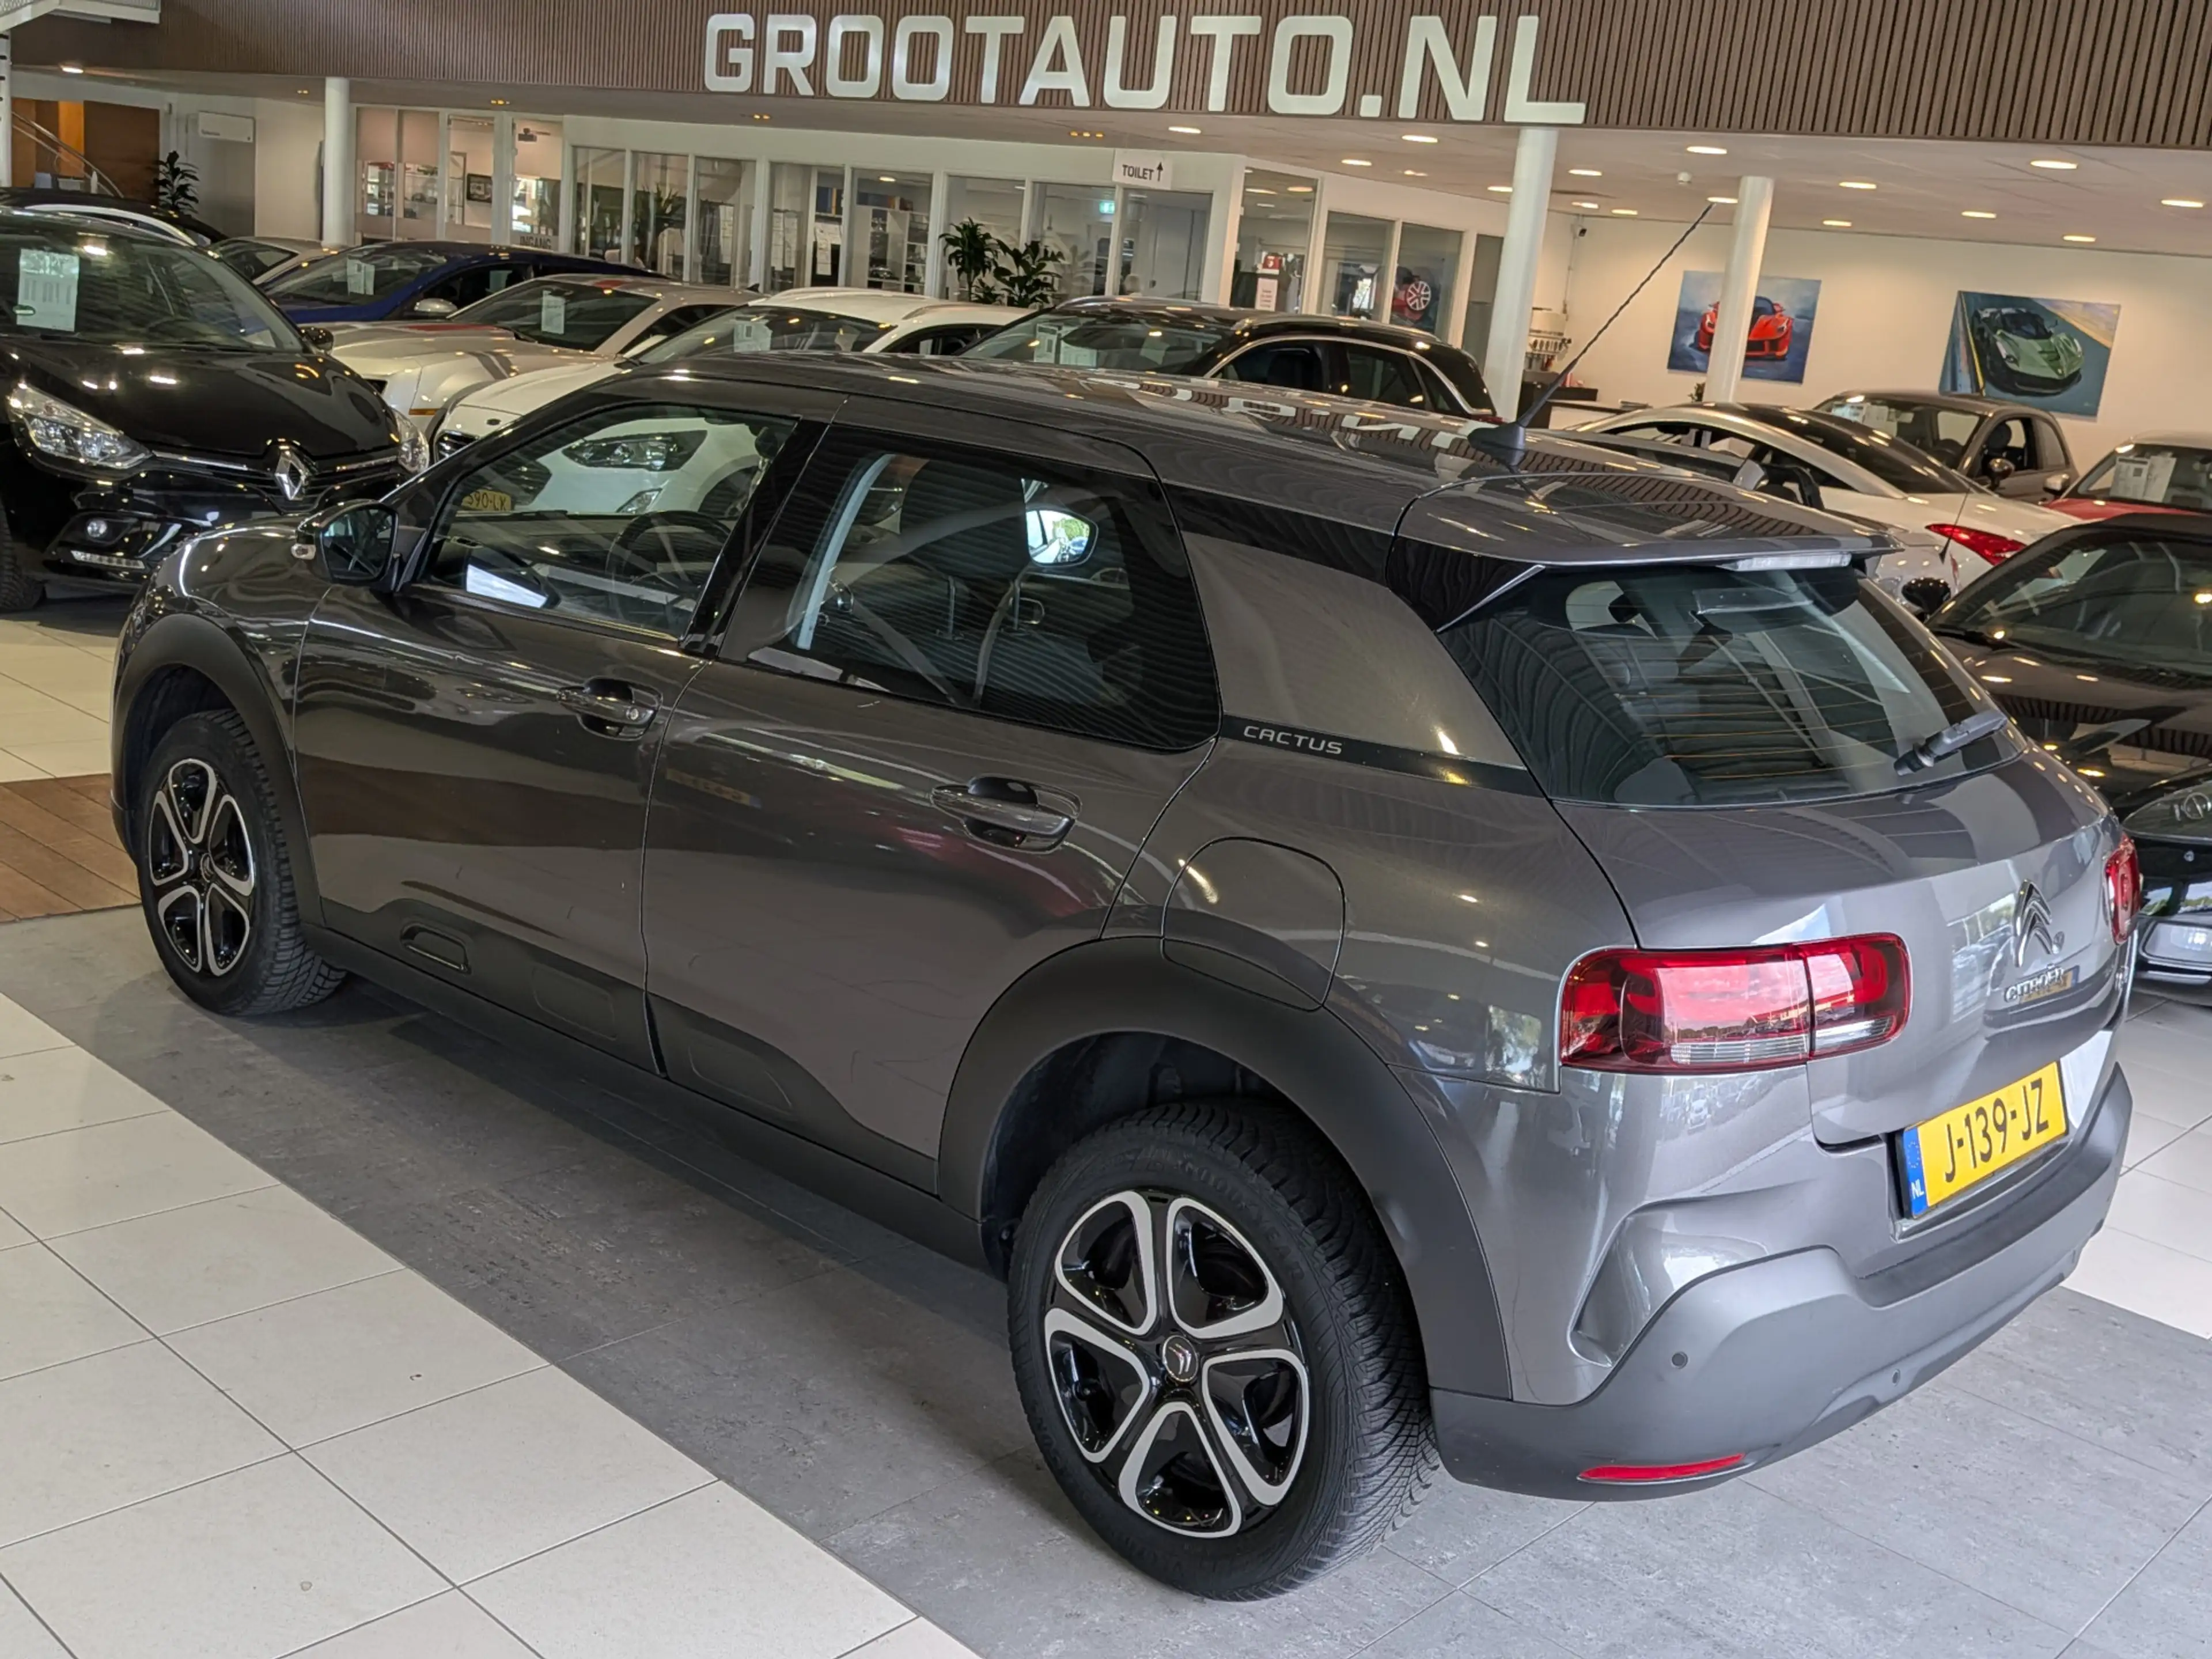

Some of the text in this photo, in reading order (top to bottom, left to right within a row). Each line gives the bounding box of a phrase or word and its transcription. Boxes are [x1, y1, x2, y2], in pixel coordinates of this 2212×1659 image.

[704, 13, 1586, 124] GROOTAUTO.NL
[1122, 164, 1155, 181] TOILET
[1243, 725, 1343, 755] CACTUS
[1945, 1077, 2050, 1183] J-139-JZ
[1911, 1179, 1925, 1199] NL
